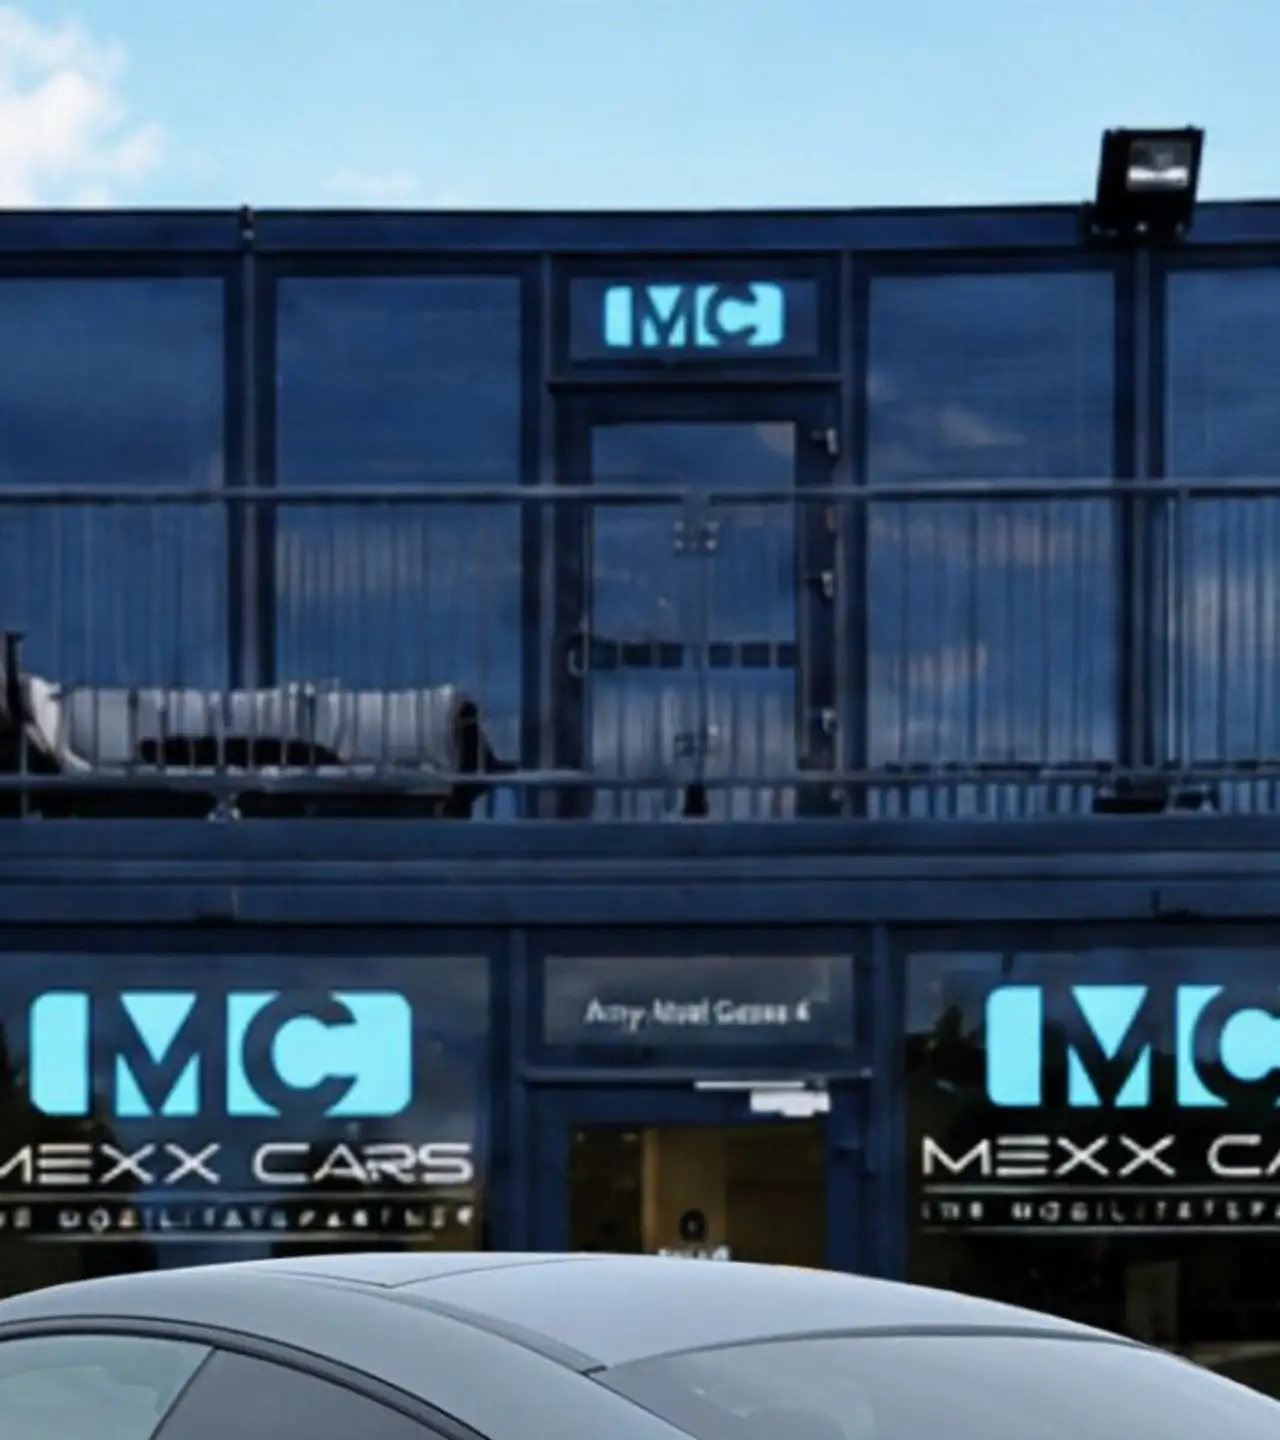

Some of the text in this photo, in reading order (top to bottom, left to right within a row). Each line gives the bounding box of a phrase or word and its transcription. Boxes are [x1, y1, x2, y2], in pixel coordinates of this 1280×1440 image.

[605, 282, 784, 347] MC
[30, 993, 413, 1117] MC
[252, 1142, 474, 1185] CARS
[922, 1135, 1176, 1177] MEXX
